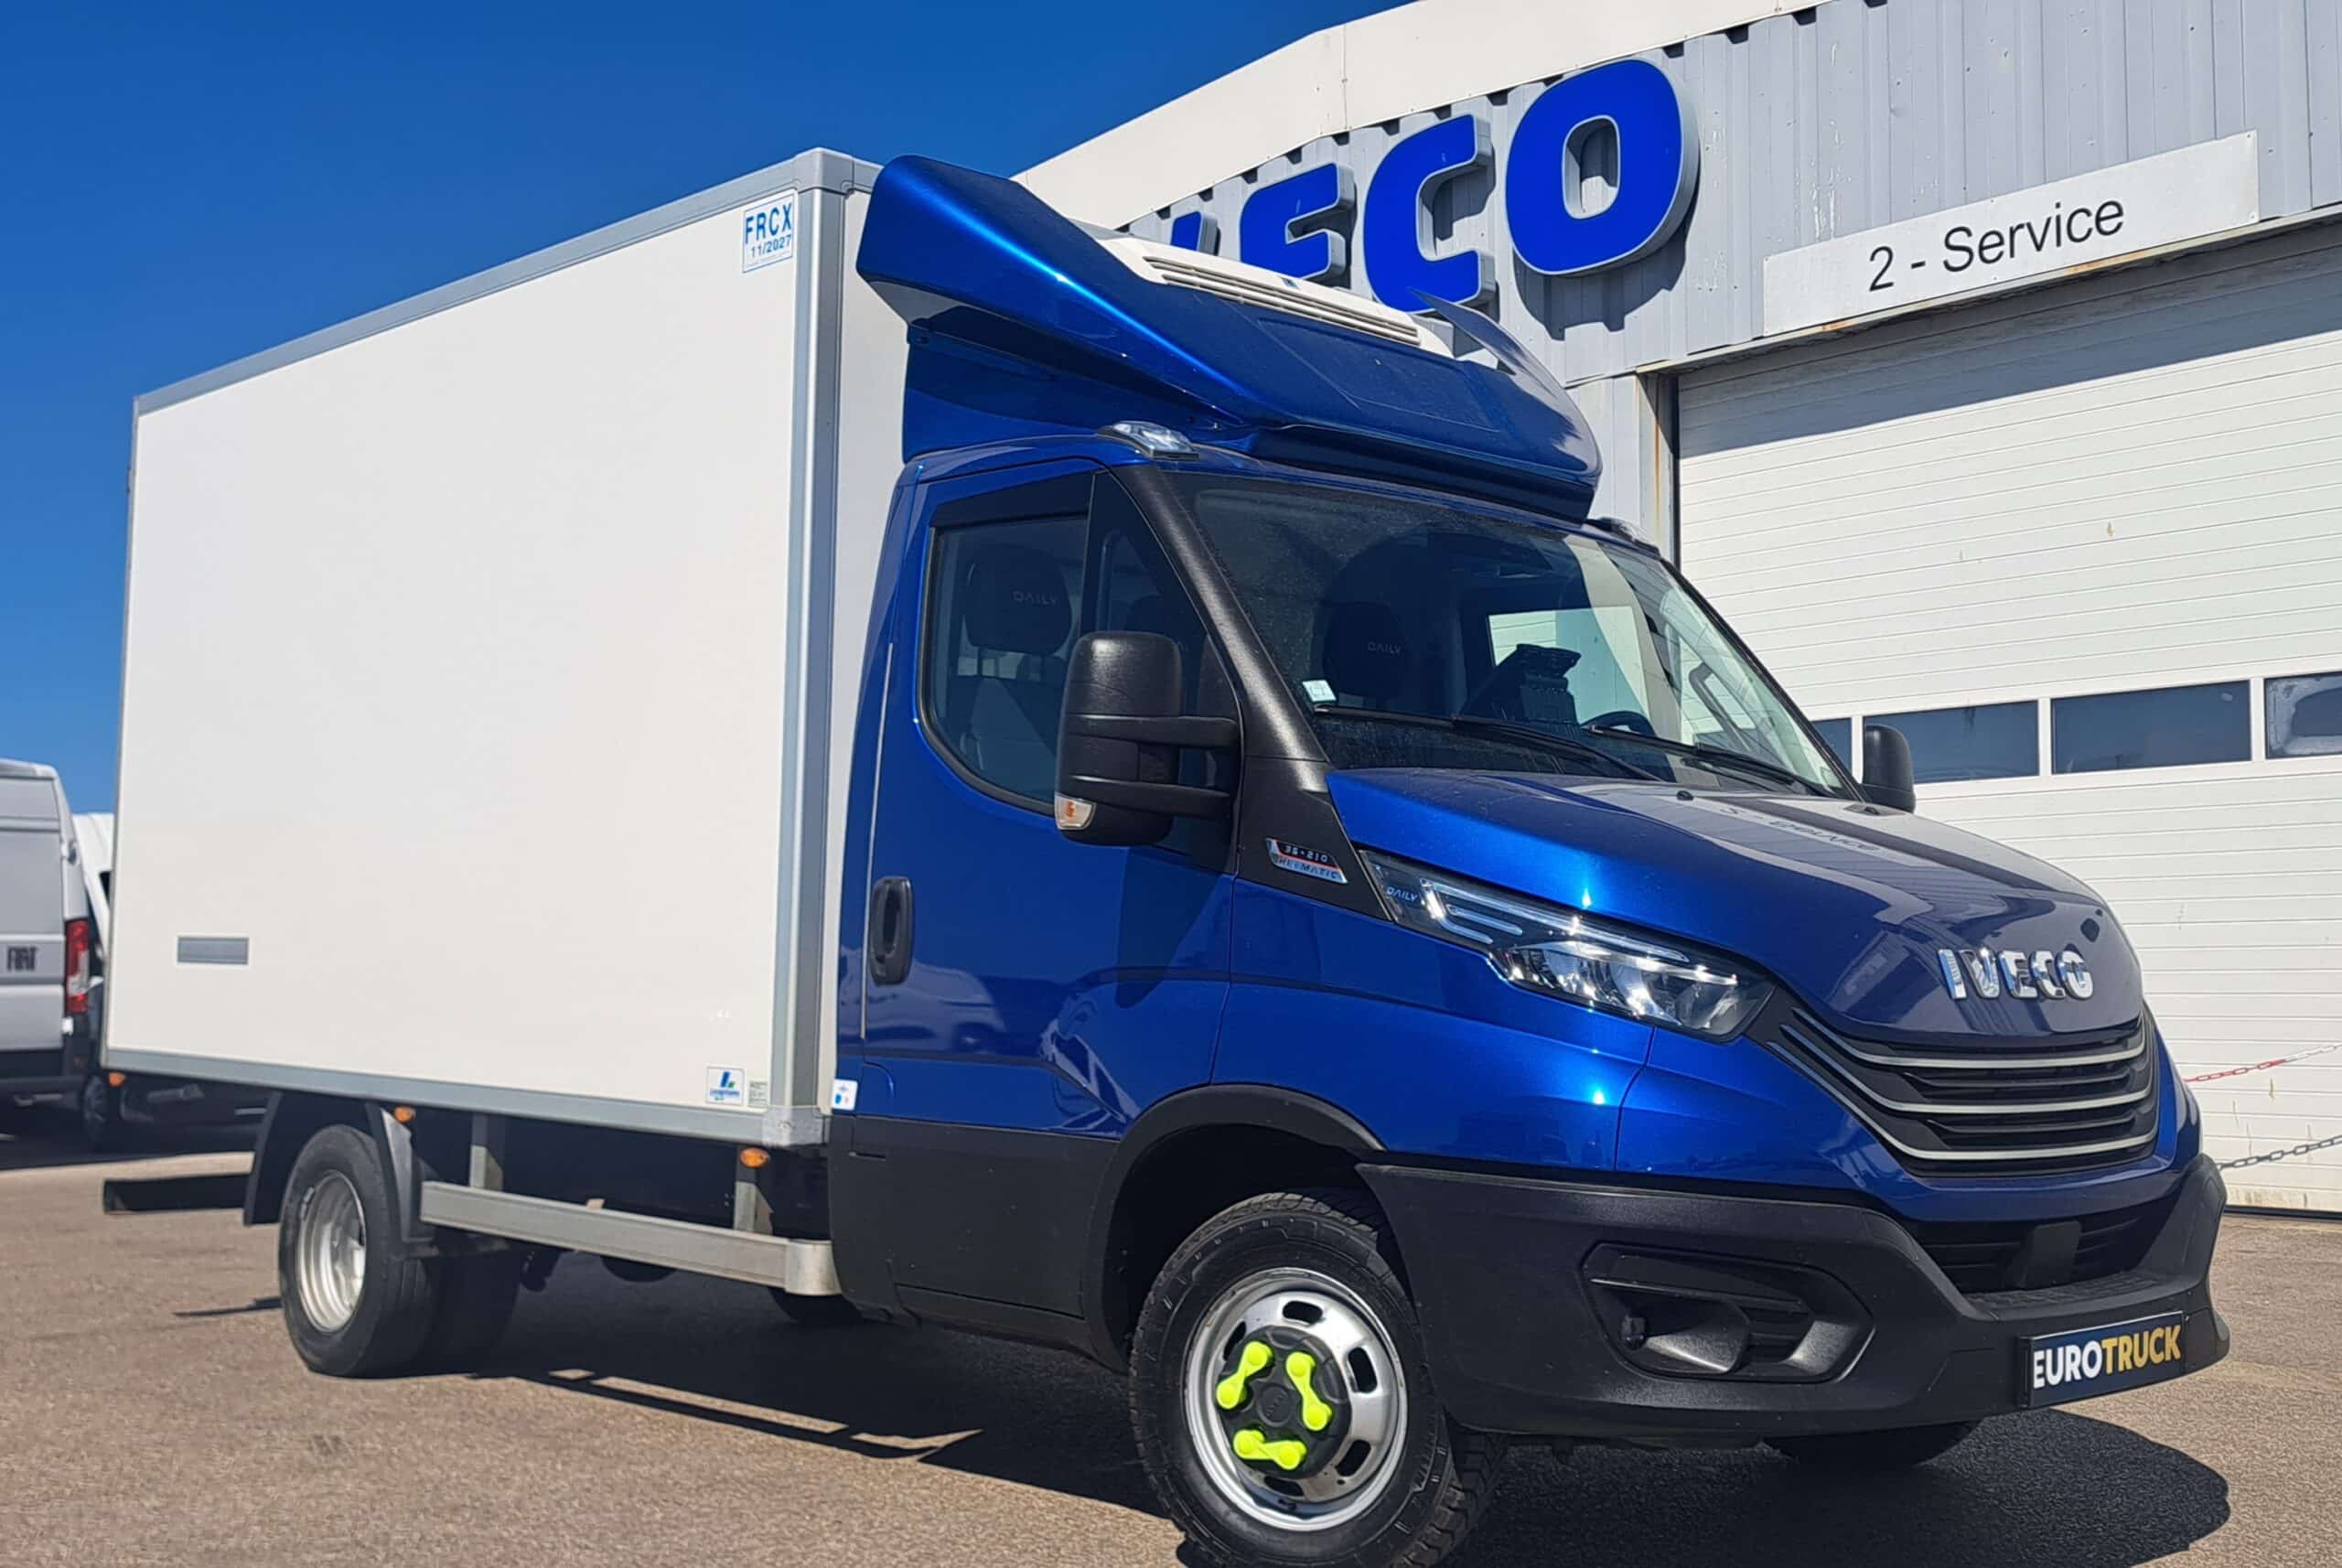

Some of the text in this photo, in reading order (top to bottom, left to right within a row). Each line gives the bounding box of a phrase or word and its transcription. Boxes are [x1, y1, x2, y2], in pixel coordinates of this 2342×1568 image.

[1171, 57, 1699, 314] ECO
[745, 202, 792, 245] FRCX
[750, 233, 792, 258] 11/2027
[1868, 199, 2125, 292] 2 - Service
[1386, 886, 1418, 902] DAILY
[7, 946, 39, 971] FIAT
[1938, 948, 2094, 1000] IVECO
[2033, 1324, 2182, 1390] EUROTRUCK
